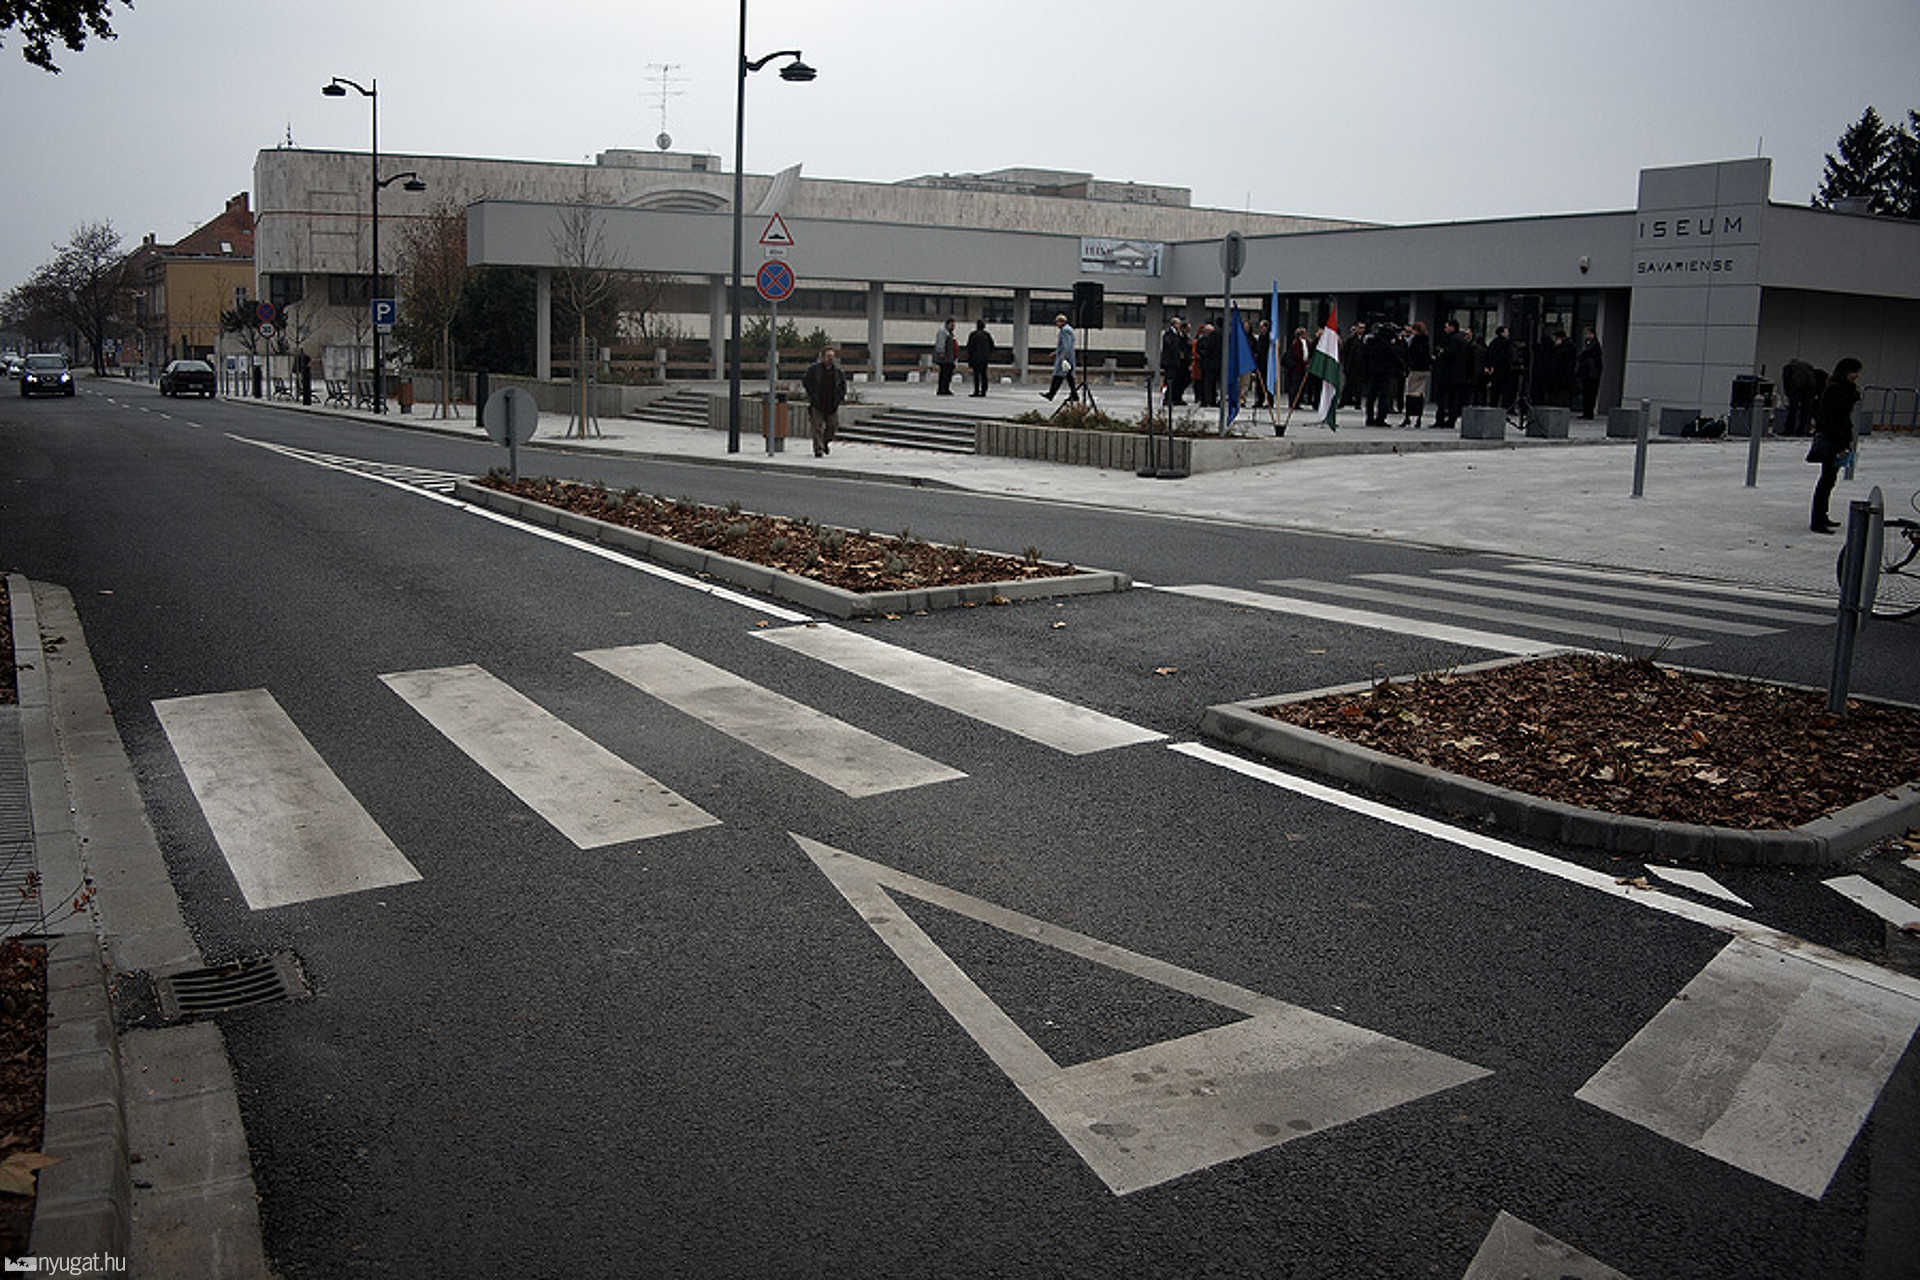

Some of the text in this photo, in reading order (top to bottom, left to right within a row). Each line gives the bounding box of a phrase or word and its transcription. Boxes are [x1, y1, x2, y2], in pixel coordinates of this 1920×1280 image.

[1639, 217, 1742, 238] ISEUM
[1637, 259, 1734, 274] SAVARIENSE
[377, 303, 391, 321] P
